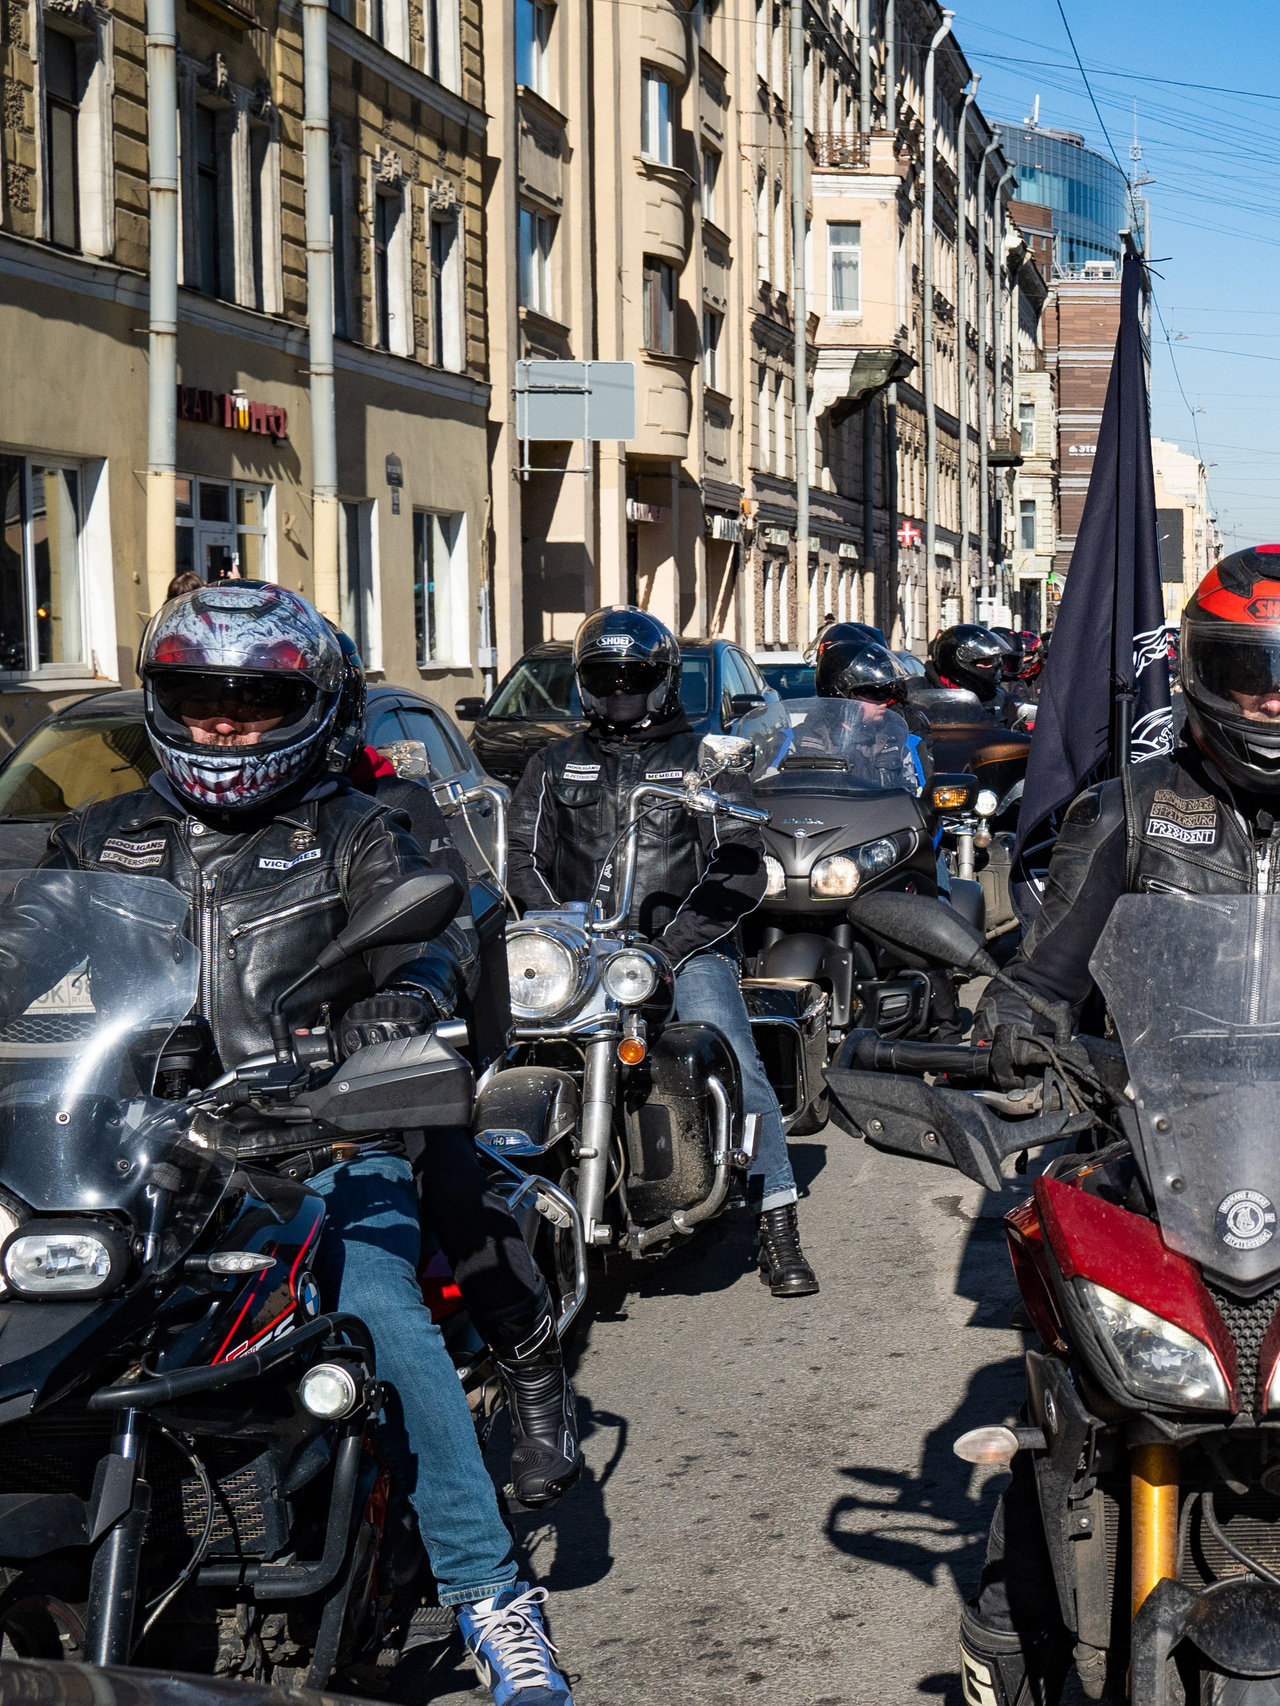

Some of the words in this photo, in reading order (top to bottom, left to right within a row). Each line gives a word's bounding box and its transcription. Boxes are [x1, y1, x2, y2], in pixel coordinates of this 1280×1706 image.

[601, 636, 630, 646] SHOEI
[1152, 821, 1212, 843] PRESIDENT
[107, 839, 165, 850] HOOLIGANS
[429, 836, 457, 853] LS
[263, 859, 289, 869] VICE
